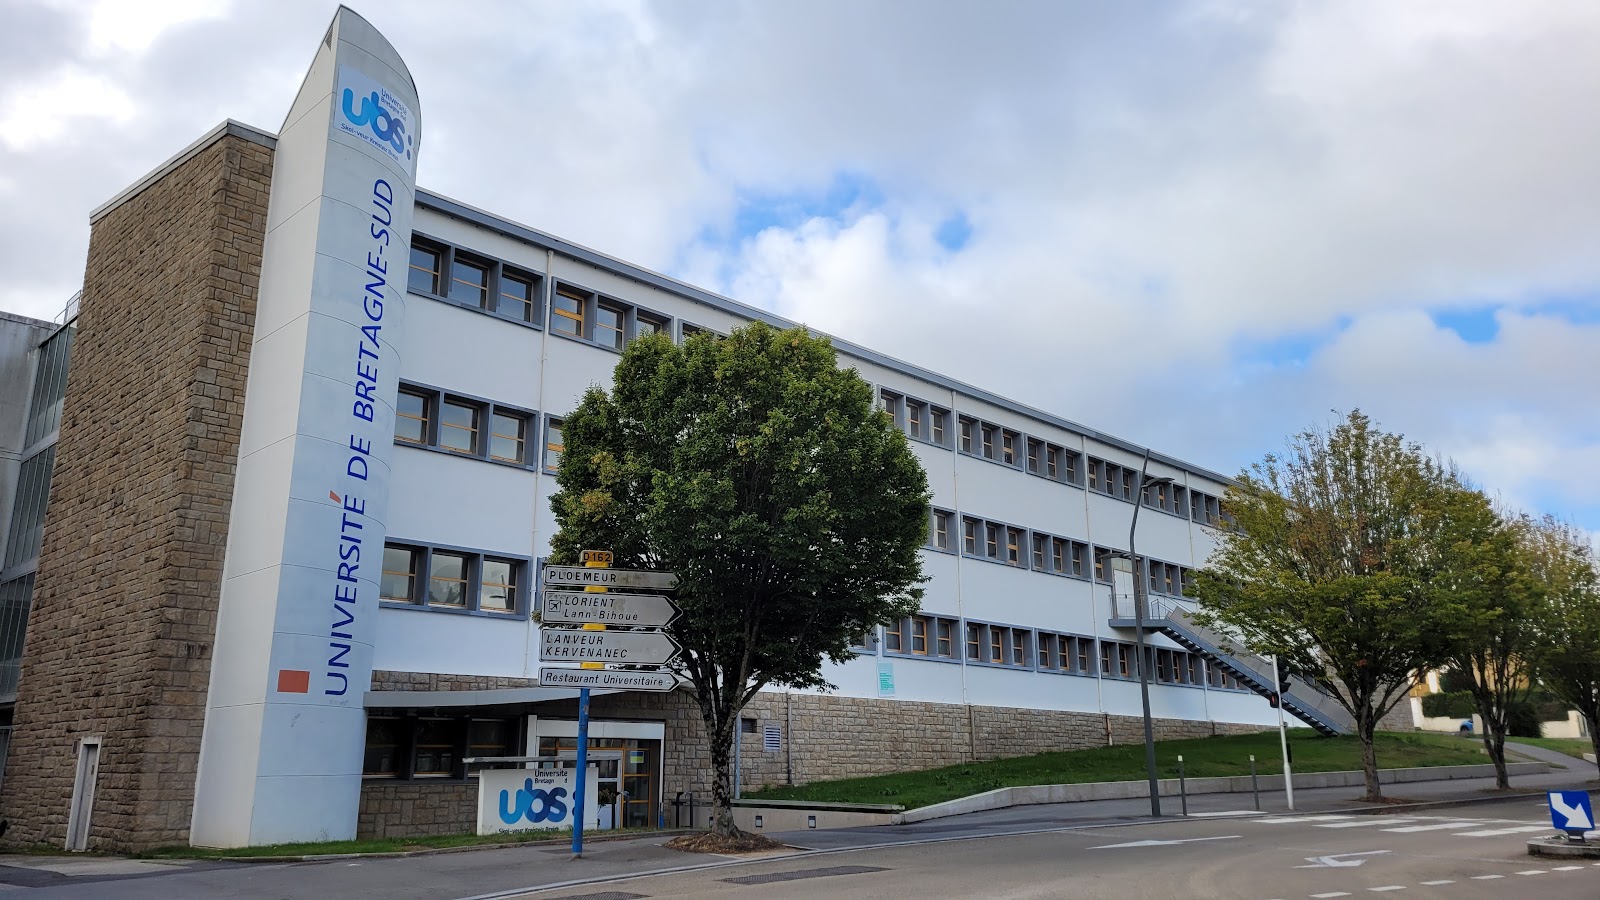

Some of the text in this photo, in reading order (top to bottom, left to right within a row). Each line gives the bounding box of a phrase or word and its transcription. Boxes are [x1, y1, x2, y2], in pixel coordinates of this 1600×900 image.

[325, 178, 394, 696] UNIVERSITÉ DE BRETAGNE-SUD
[549, 570, 616, 583] PLOEMEUR
[564, 596, 616, 608] LORIENT
[546, 634, 604, 645] LANVEUR
[545, 647, 628, 658] KERVENANEC
[545, 672, 663, 686] Restaurant Universitaire
